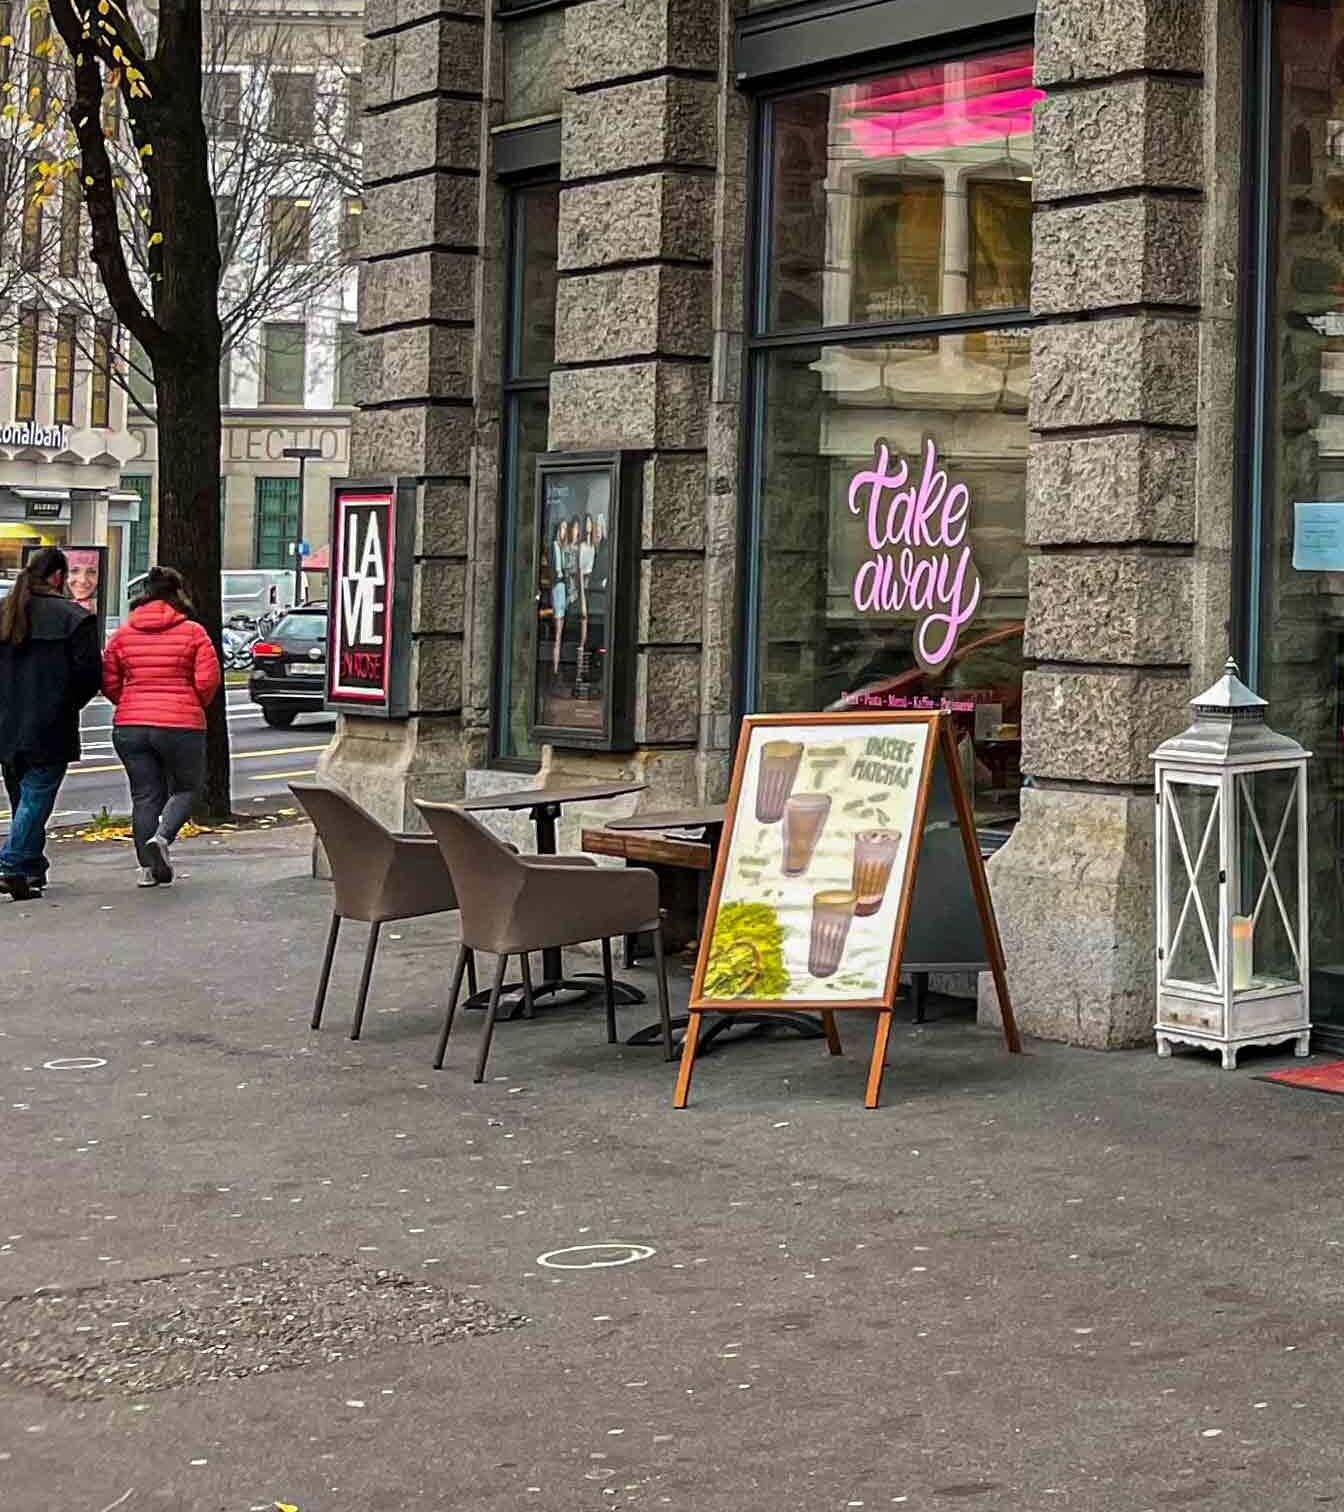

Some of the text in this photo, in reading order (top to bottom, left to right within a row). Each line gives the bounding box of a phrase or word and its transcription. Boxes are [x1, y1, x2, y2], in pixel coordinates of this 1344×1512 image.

[349, 511, 385, 585] LA
[848, 439, 970, 549] take
[854, 545, 980, 666] away
